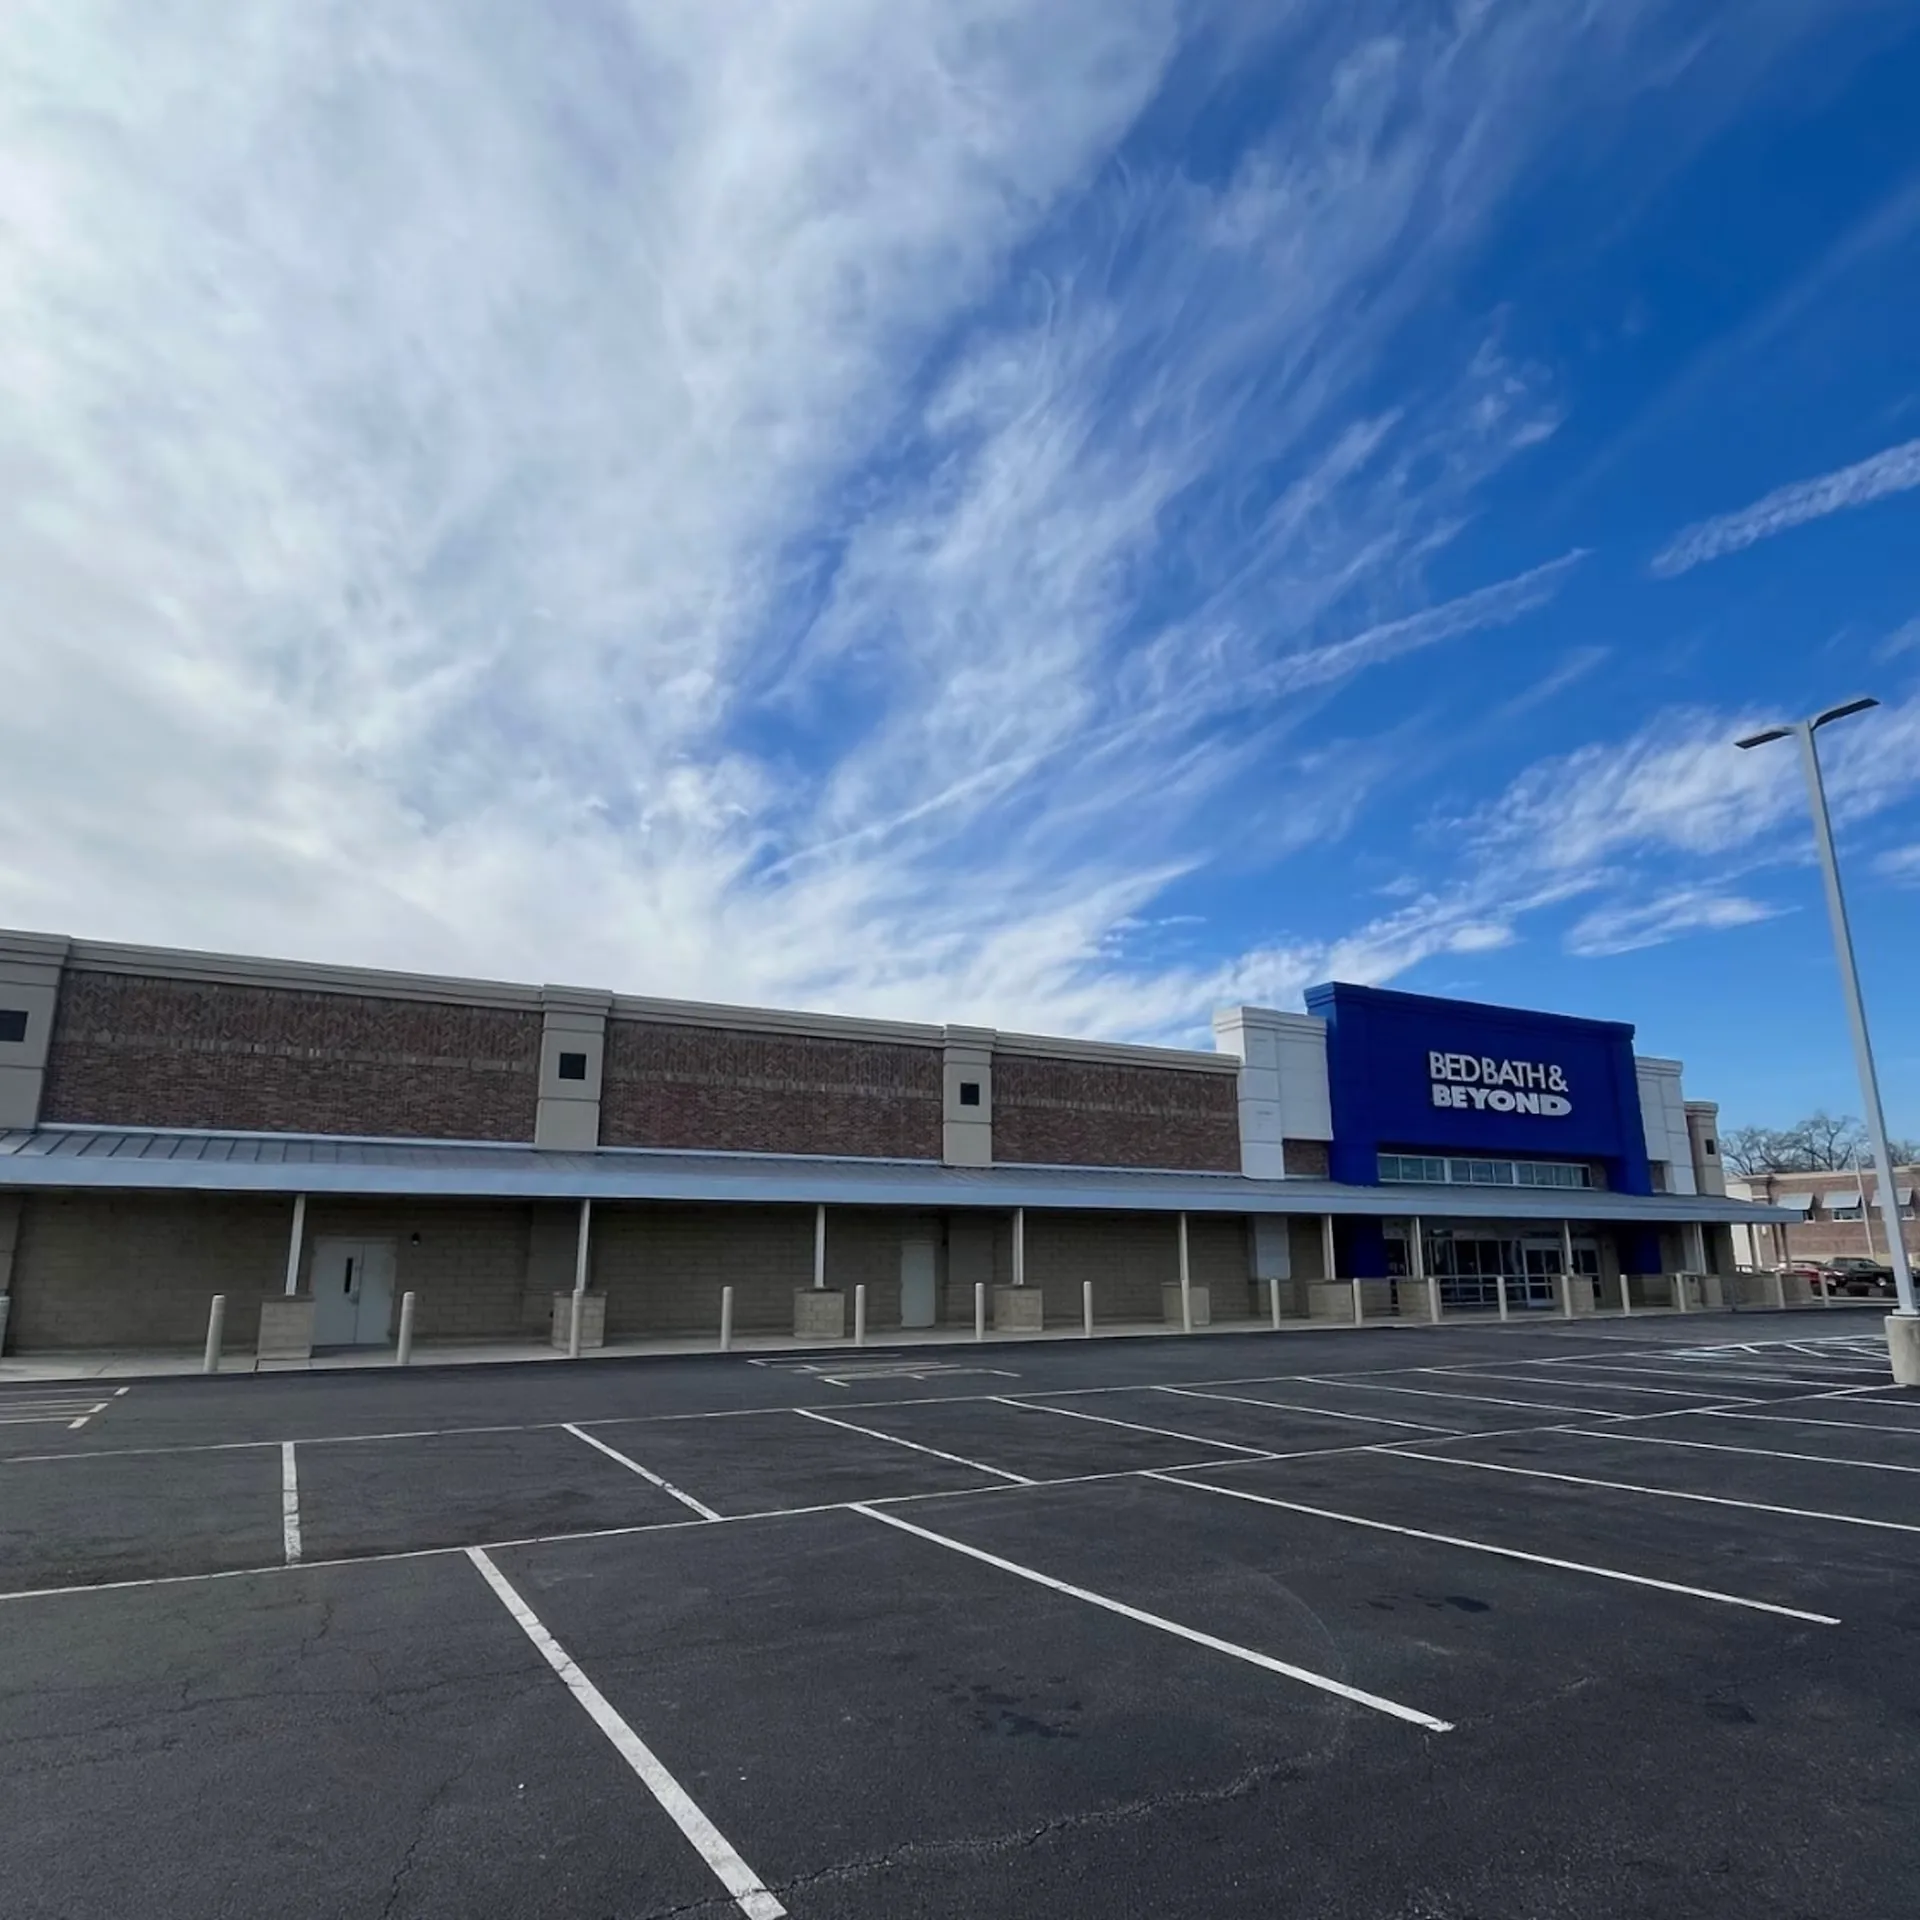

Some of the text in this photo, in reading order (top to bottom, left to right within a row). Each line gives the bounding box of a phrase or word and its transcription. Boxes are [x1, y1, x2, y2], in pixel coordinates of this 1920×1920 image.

[1429, 1051, 1569, 1092] BED BATH &
[1431, 1084, 1572, 1116] BEYOND
